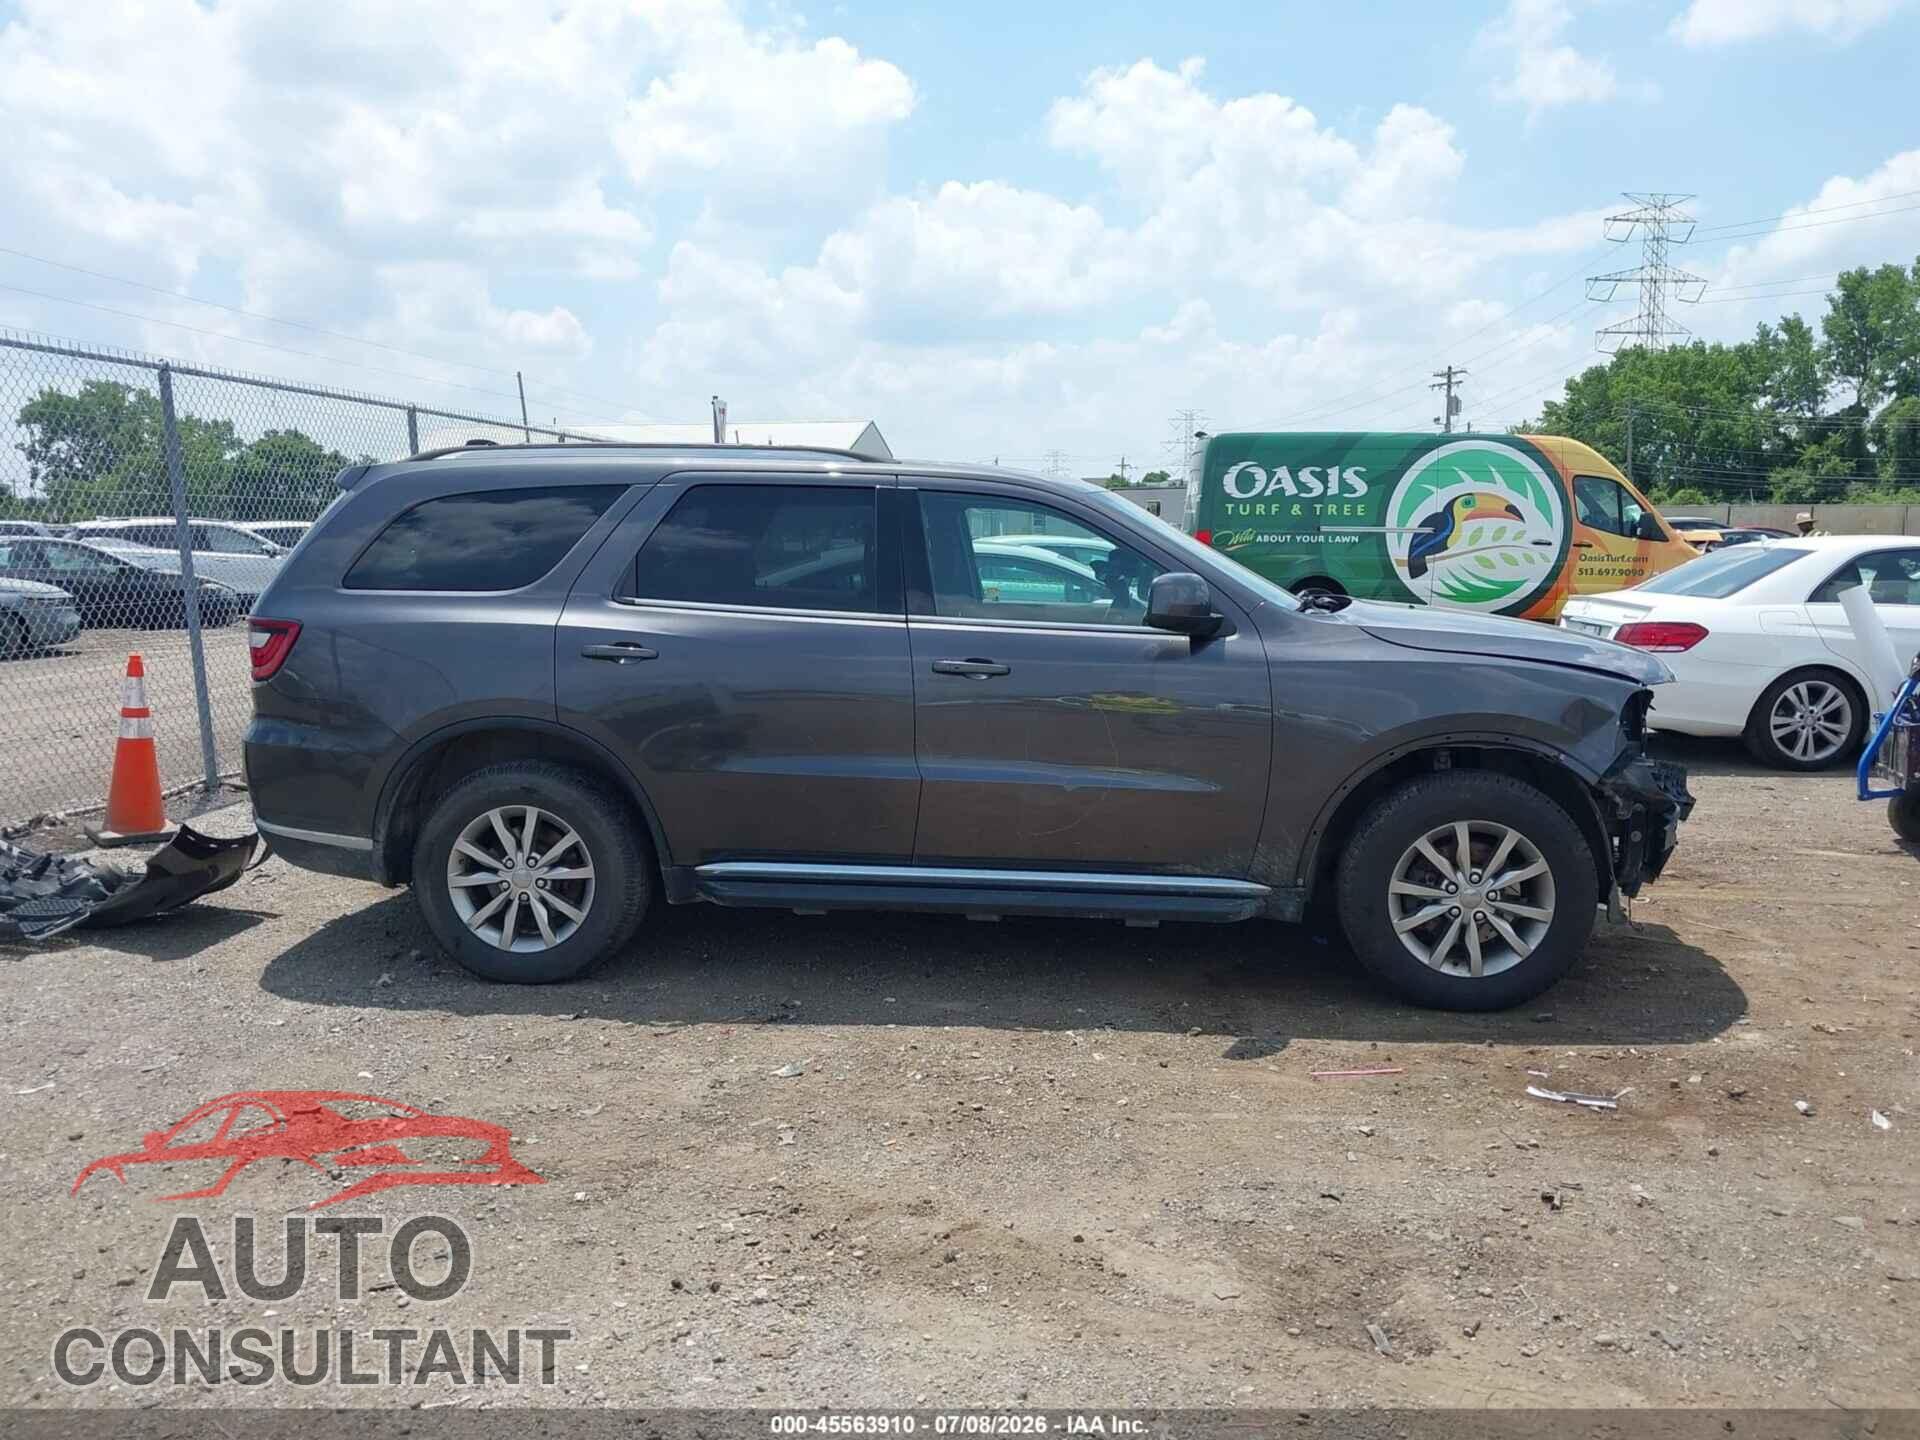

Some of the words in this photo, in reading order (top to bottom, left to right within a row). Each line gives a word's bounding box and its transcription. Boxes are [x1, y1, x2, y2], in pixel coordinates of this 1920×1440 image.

[1222, 461, 1369, 499] OASIS
[1225, 503, 1281, 516] TURF
[1290, 503, 1303, 516] &
[1313, 503, 1367, 516] TREE
[1212, 528, 1256, 546] Wild
[1256, 534, 1291, 543] ABOUT
[1295, 534, 1325, 543] YOUR
[1328, 535, 1359, 543] LAWN
[1578, 553, 1649, 563] OasisTurf.com
[1577, 567, 1645, 577] 513.697.9090
